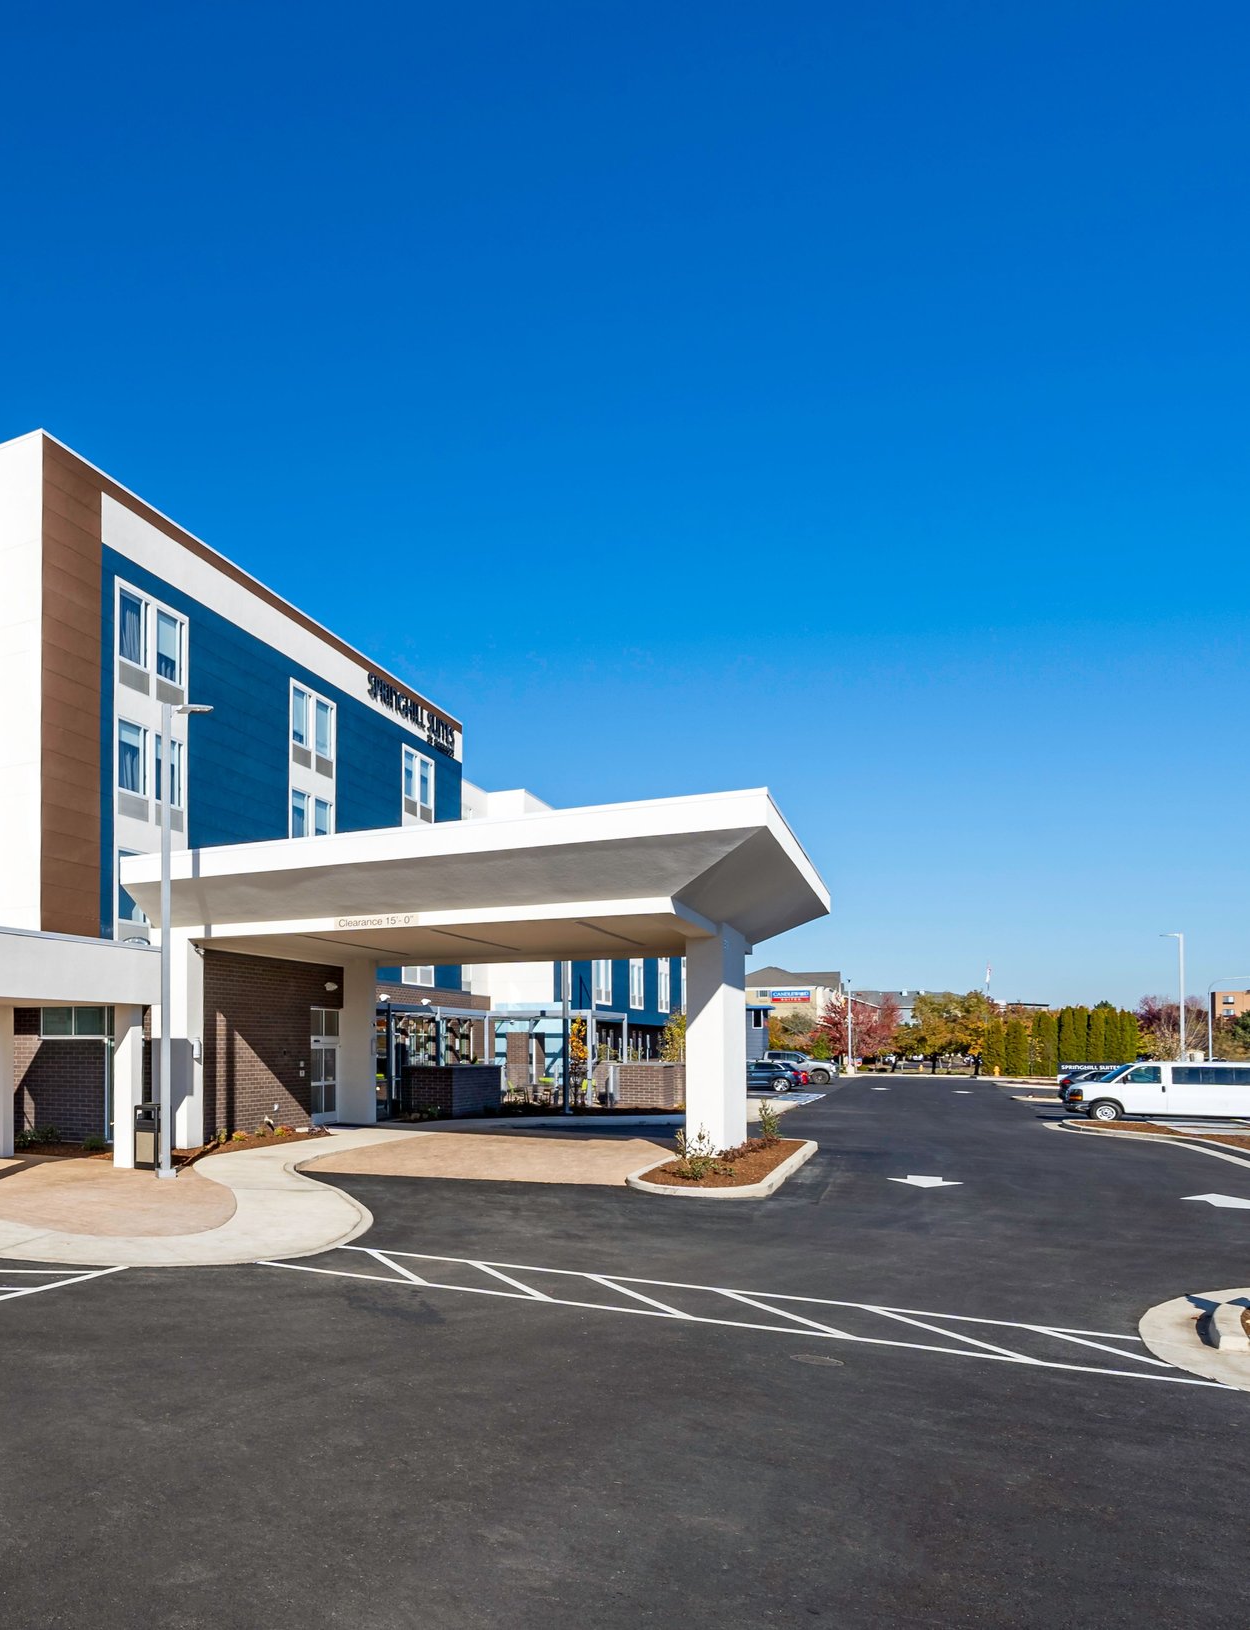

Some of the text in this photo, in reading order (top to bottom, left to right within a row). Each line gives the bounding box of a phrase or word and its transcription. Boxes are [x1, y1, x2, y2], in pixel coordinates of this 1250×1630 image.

[367, 672, 426, 733] SPRINGHILL
[427, 711, 455, 748] SUITES
[338, 918, 383, 928] Clearance
